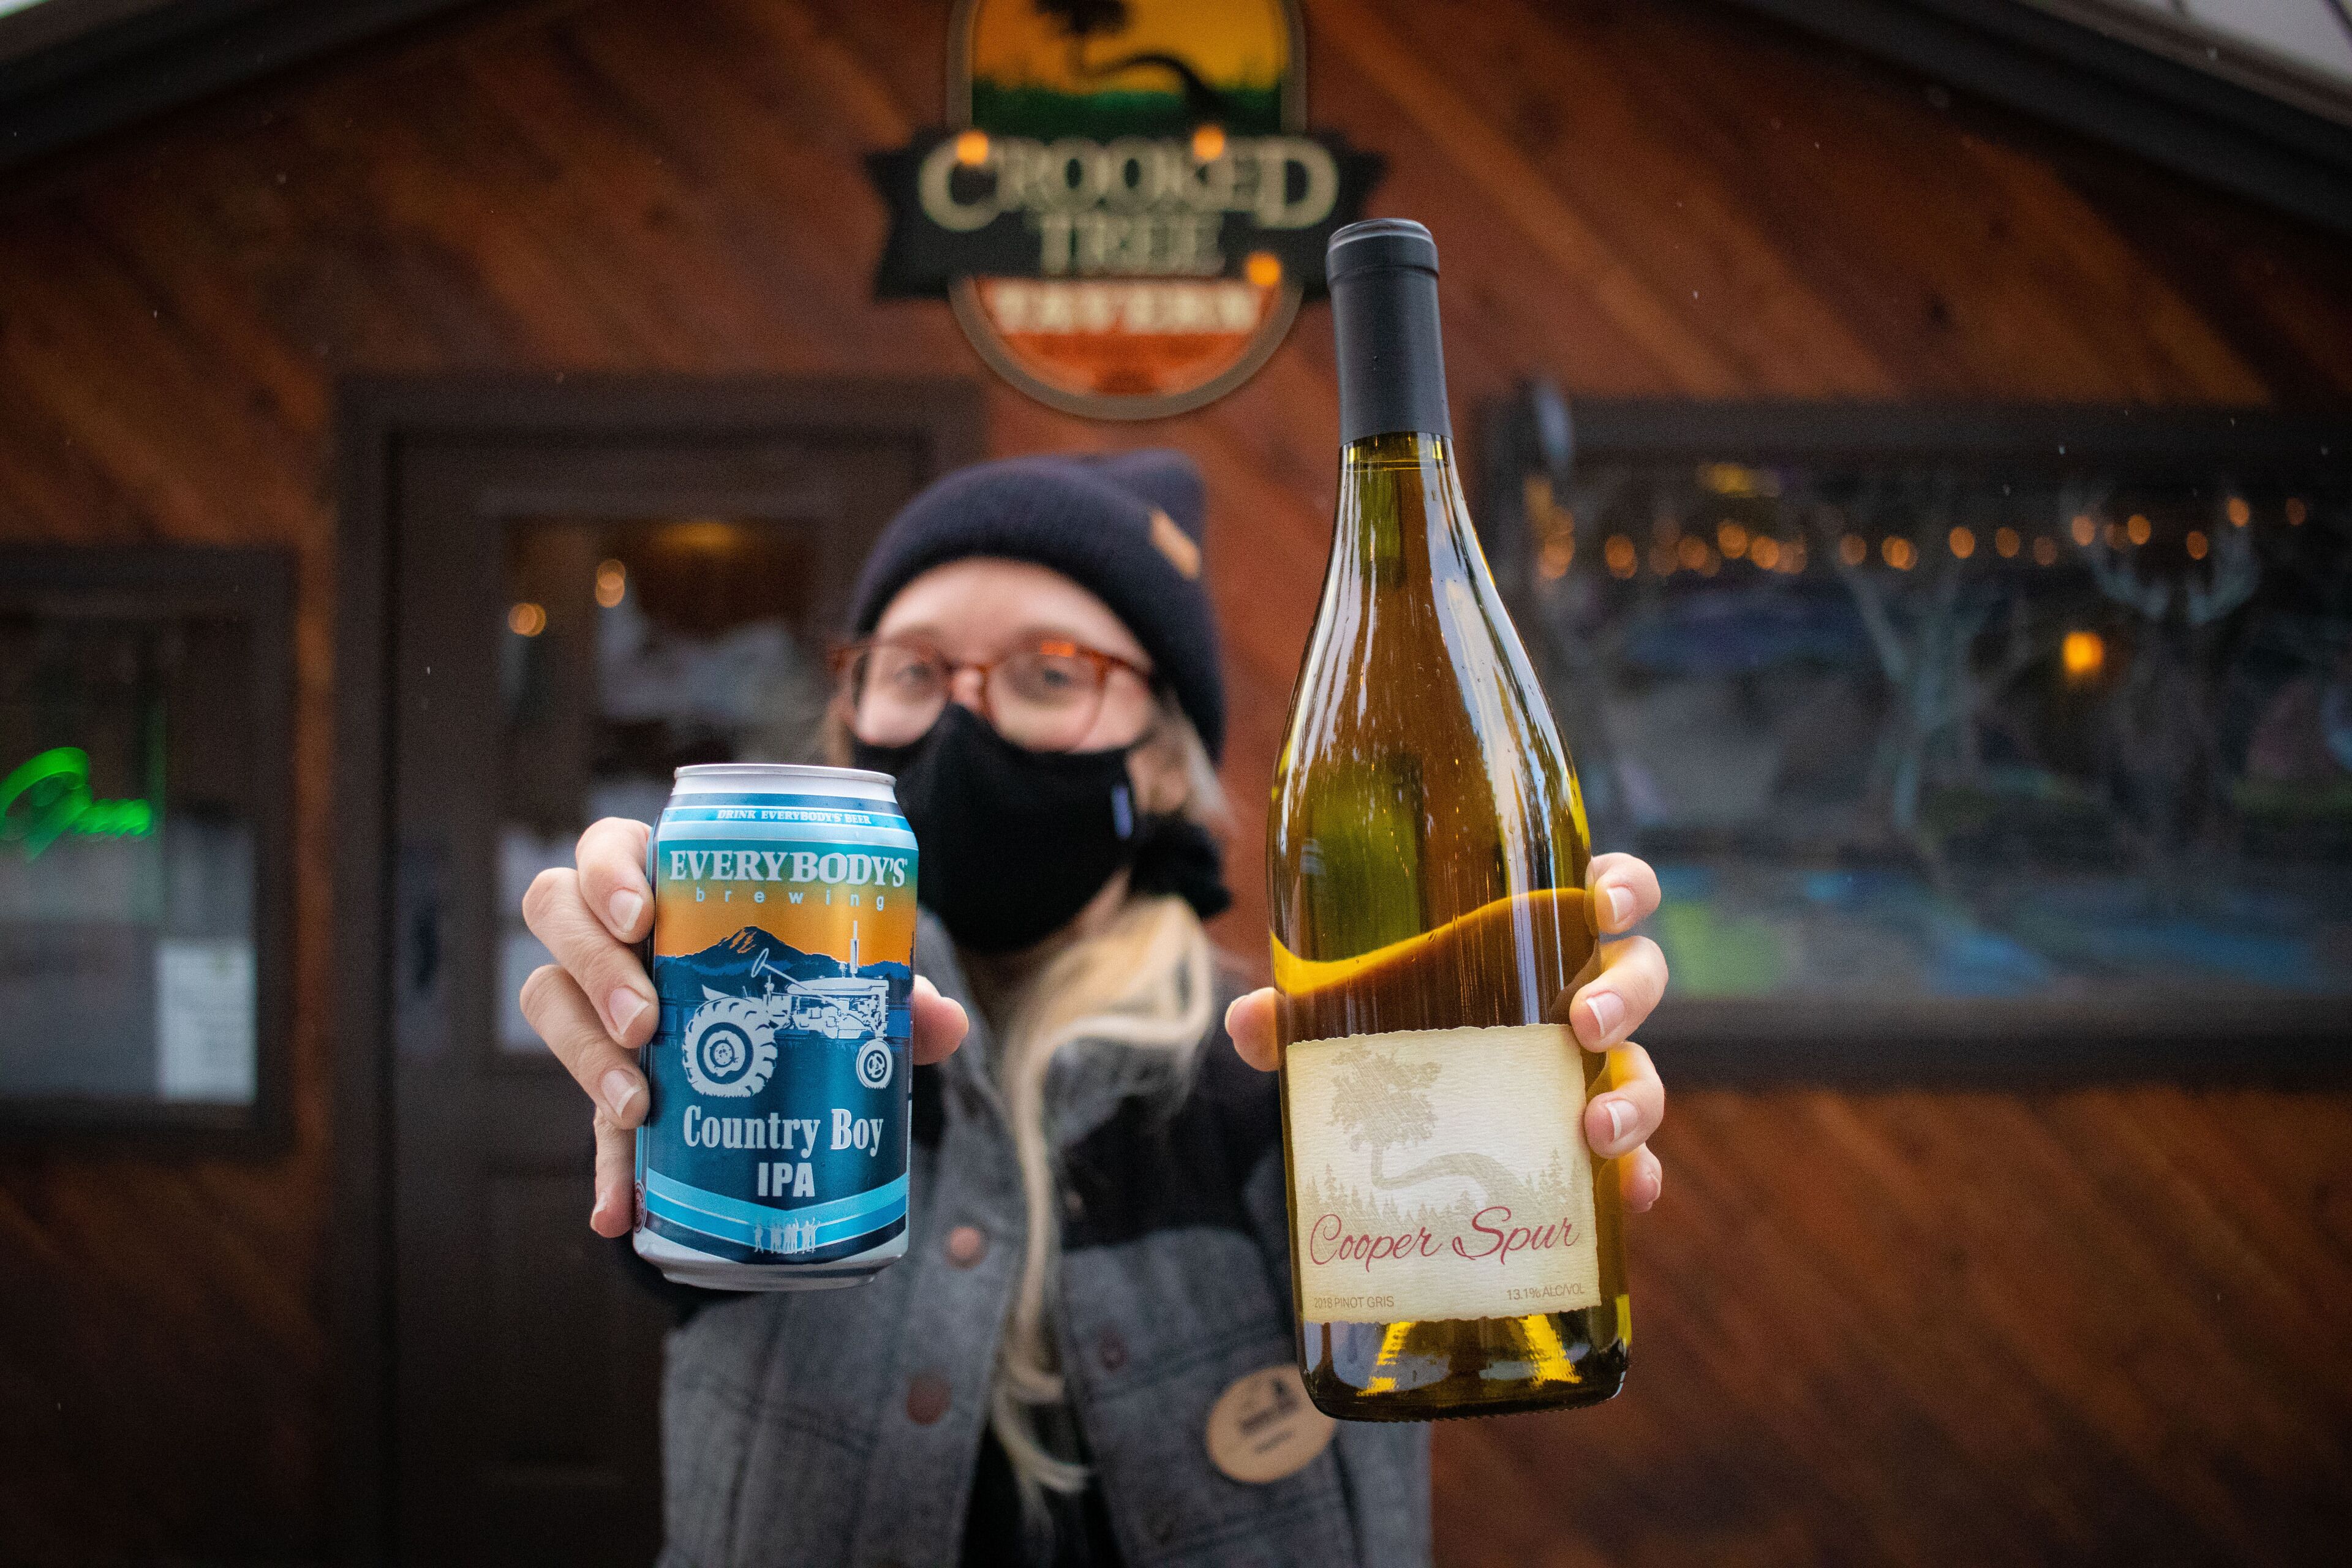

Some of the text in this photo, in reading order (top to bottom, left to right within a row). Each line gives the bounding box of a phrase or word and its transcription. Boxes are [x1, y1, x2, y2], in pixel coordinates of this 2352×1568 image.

[717, 809, 872, 824] DRINK EVERYBODY'S BEER
[669, 850, 908, 888] EVERYBODY'S
[683, 1104, 884, 1158] Country Boy
[758, 1161, 816, 1198] IPA
[1310, 1205, 1580, 1273] Cooper Spur
[1313, 1295, 1395, 1309] 2018 PINOT GRIS
